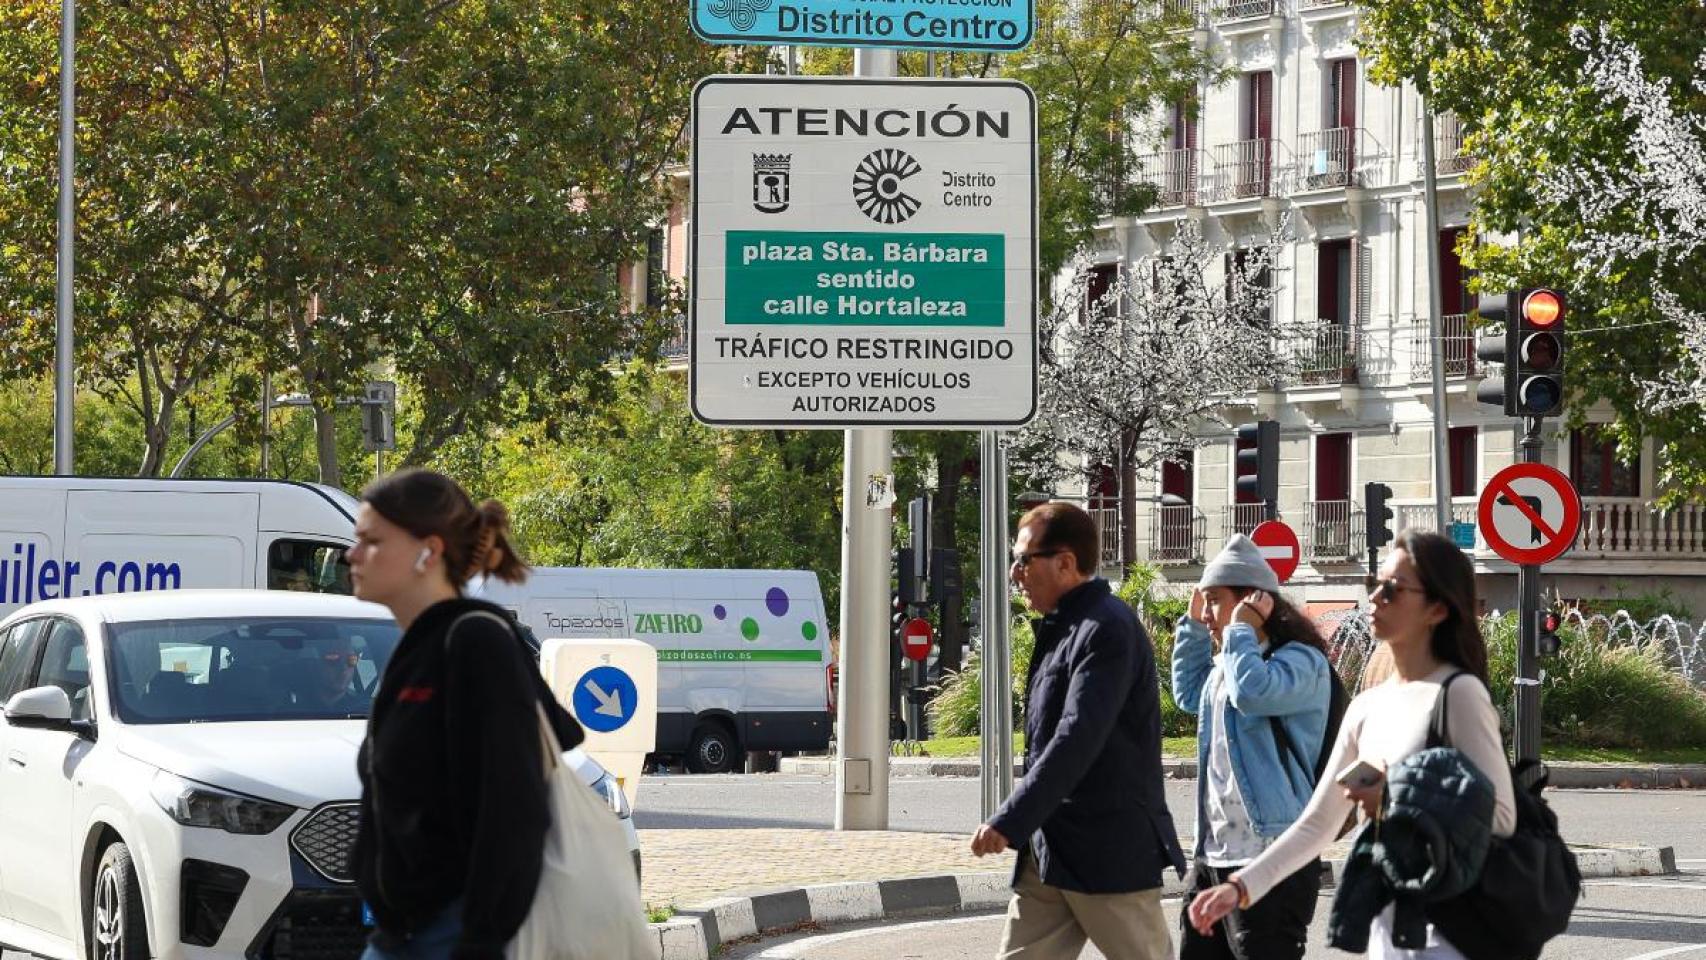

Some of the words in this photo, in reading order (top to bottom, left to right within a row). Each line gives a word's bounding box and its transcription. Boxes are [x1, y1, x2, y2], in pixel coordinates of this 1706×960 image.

[778, 6, 893, 35] Distrito
[903, 10, 1018, 40] Centro
[721, 104, 1009, 138] ATENCIÓN
[942, 170, 996, 187] Distrito
[943, 191, 992, 207] Centro
[743, 241, 813, 265] plaza
[822, 241, 874, 261] Sta.
[883, 242, 988, 263] Bárbara
[816, 269, 915, 289] sentido
[763, 295, 829, 315] calle
[838, 295, 967, 317] Hortaleza
[714, 333, 828, 359] TRÁFICO
[837, 338, 1013, 361] RESTRINGIDO
[758, 371, 851, 388] EXCEPTO
[857, 368, 971, 389] VEHÍCULOS
[791, 396, 936, 413] AUTORIZADOS
[634, 613, 702, 634] ZAFIRO
